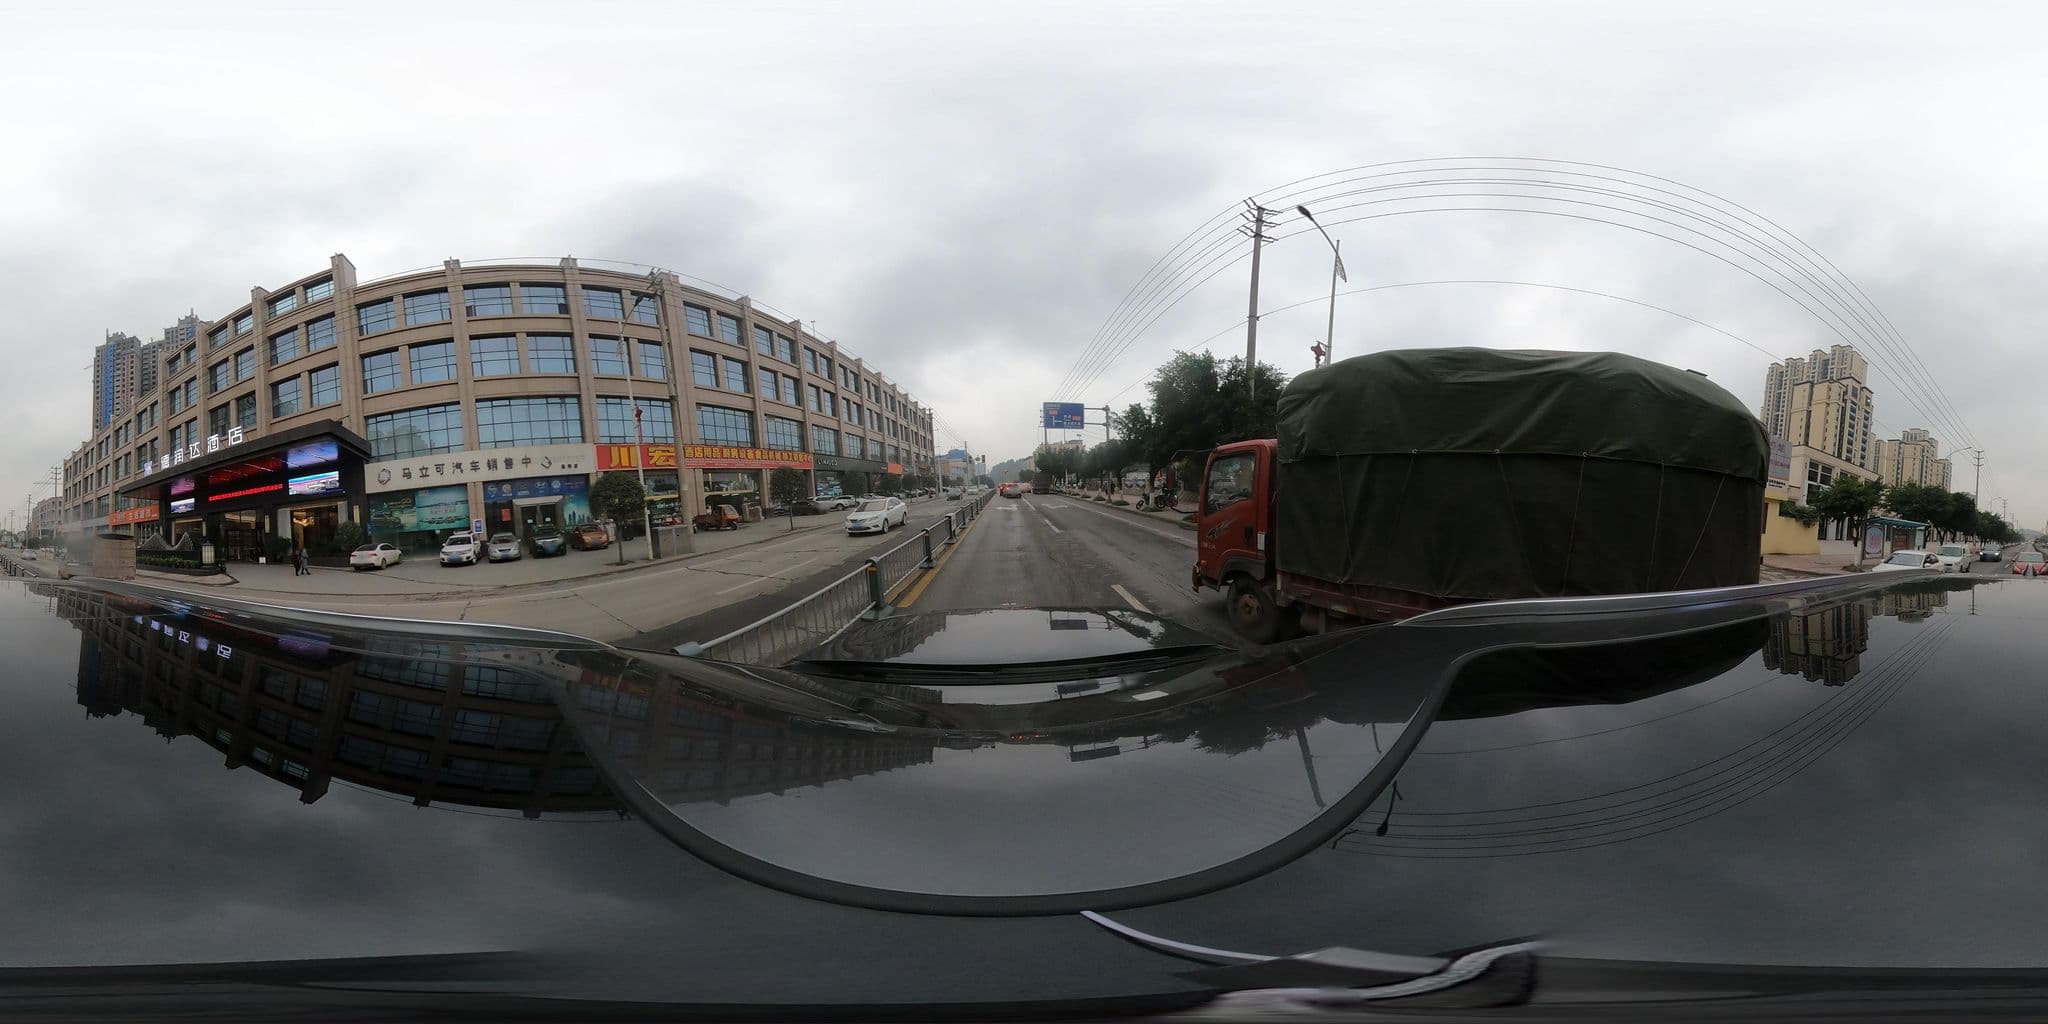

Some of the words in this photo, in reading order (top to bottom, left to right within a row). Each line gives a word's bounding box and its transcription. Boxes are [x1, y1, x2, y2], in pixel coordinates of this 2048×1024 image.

[401, 455, 553, 480] 马立可汽车销售中心
